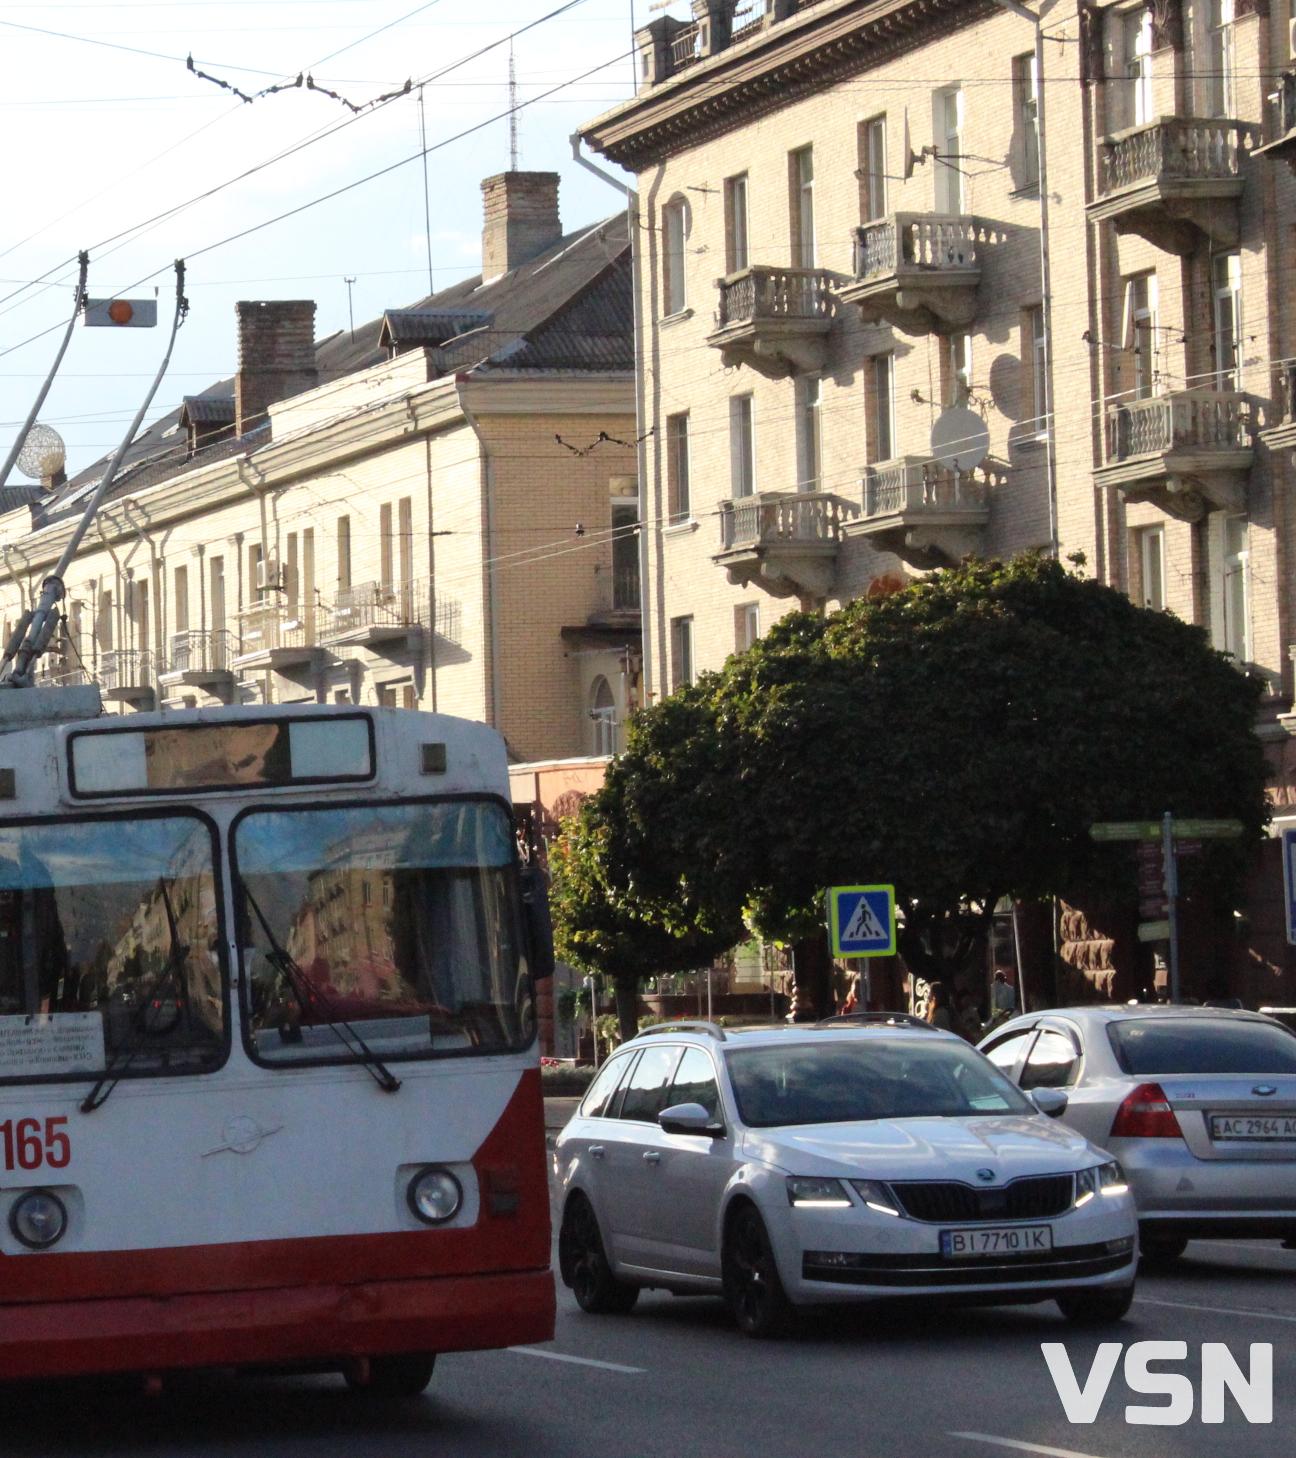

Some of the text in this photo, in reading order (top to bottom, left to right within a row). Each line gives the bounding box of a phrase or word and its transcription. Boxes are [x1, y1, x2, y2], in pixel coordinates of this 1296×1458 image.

[1223, 1120, 1242, 1134] AC
[1247, 1120, 1278, 1134] 2964
[953, 1230, 1045, 1251] BI 7710 IK
